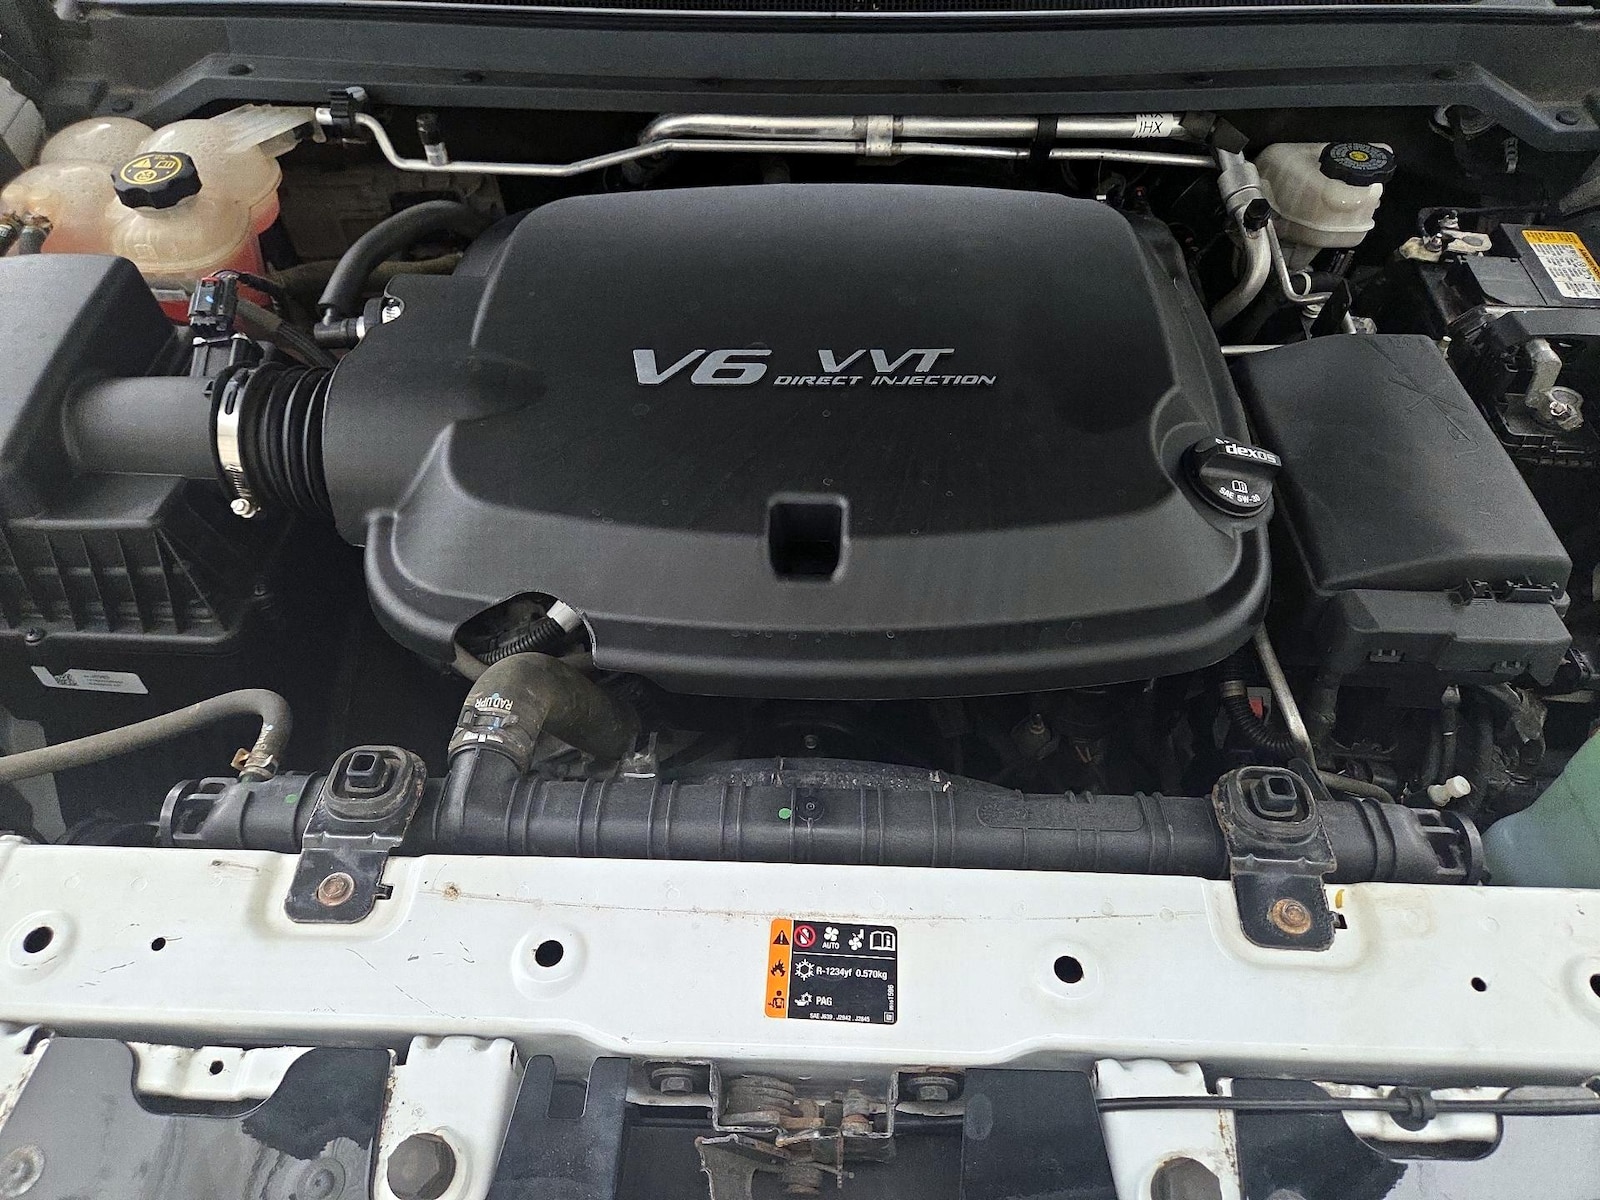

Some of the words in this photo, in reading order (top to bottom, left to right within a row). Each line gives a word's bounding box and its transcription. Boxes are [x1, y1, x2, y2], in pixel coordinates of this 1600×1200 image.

[1138, 121, 1163, 133] IHX
[632, 348, 772, 385] V6
[818, 348, 955, 373] VVT
[773, 375, 864, 386] DIRECT
[870, 375, 996, 386] INJECTION
[1225, 443, 1276, 464] dexos
[1219, 486, 1234, 500] SAE
[1236, 493, 1261, 503] 5W-30
[474, 697, 493, 709] UPR
[493, 697, 514, 711] RAD
[822, 941, 840, 950] AUTO
[816, 966, 852, 978] R-1234yf
[855, 969, 888, 981] 0.570kg
[816, 996, 833, 1006] PAG
